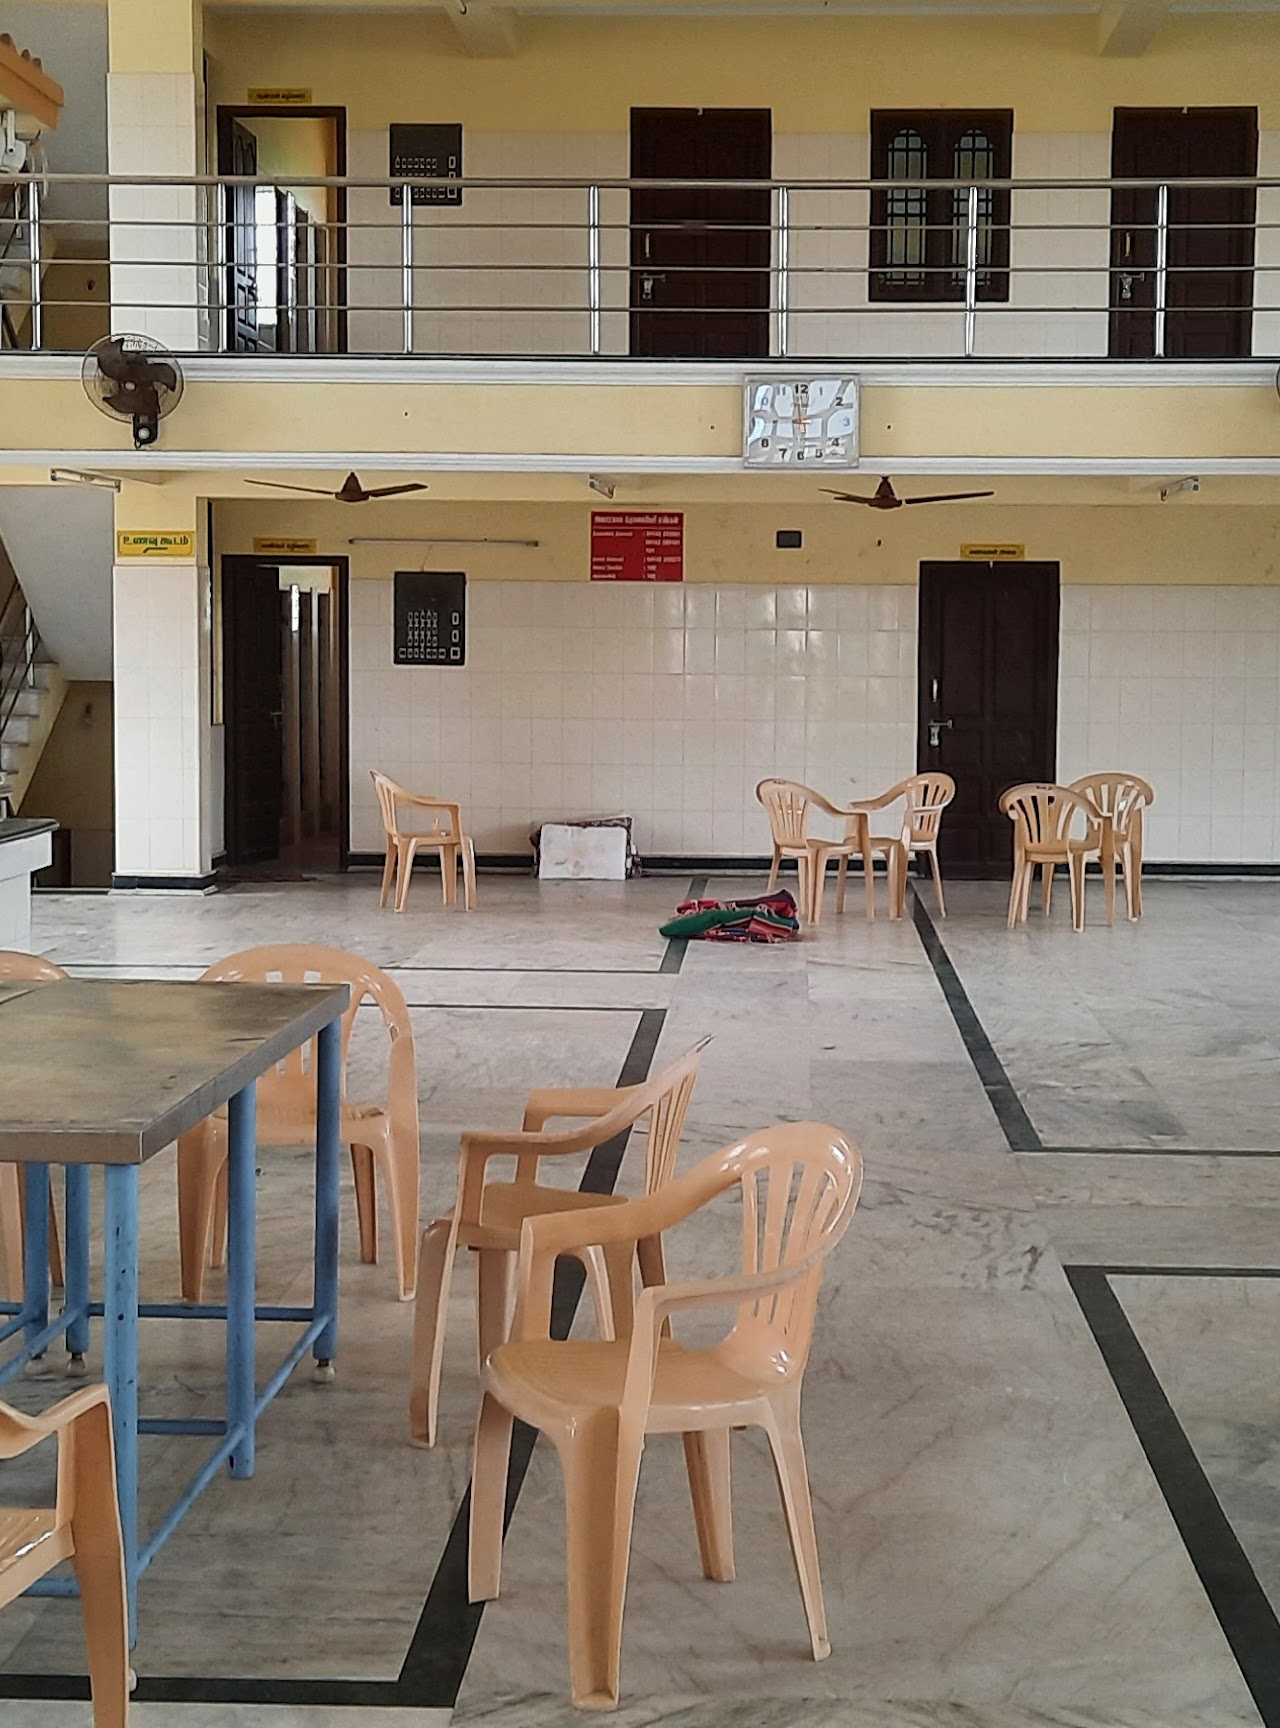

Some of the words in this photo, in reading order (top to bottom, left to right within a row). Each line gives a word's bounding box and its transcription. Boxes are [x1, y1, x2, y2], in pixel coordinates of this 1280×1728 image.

[794, 383, 809, 395] 12
[835, 397, 844, 406] 2
[843, 416, 852, 427] 3
[761, 438, 770, 448] 8
[831, 438, 839, 446] 4
[779, 448, 788, 458] 7
